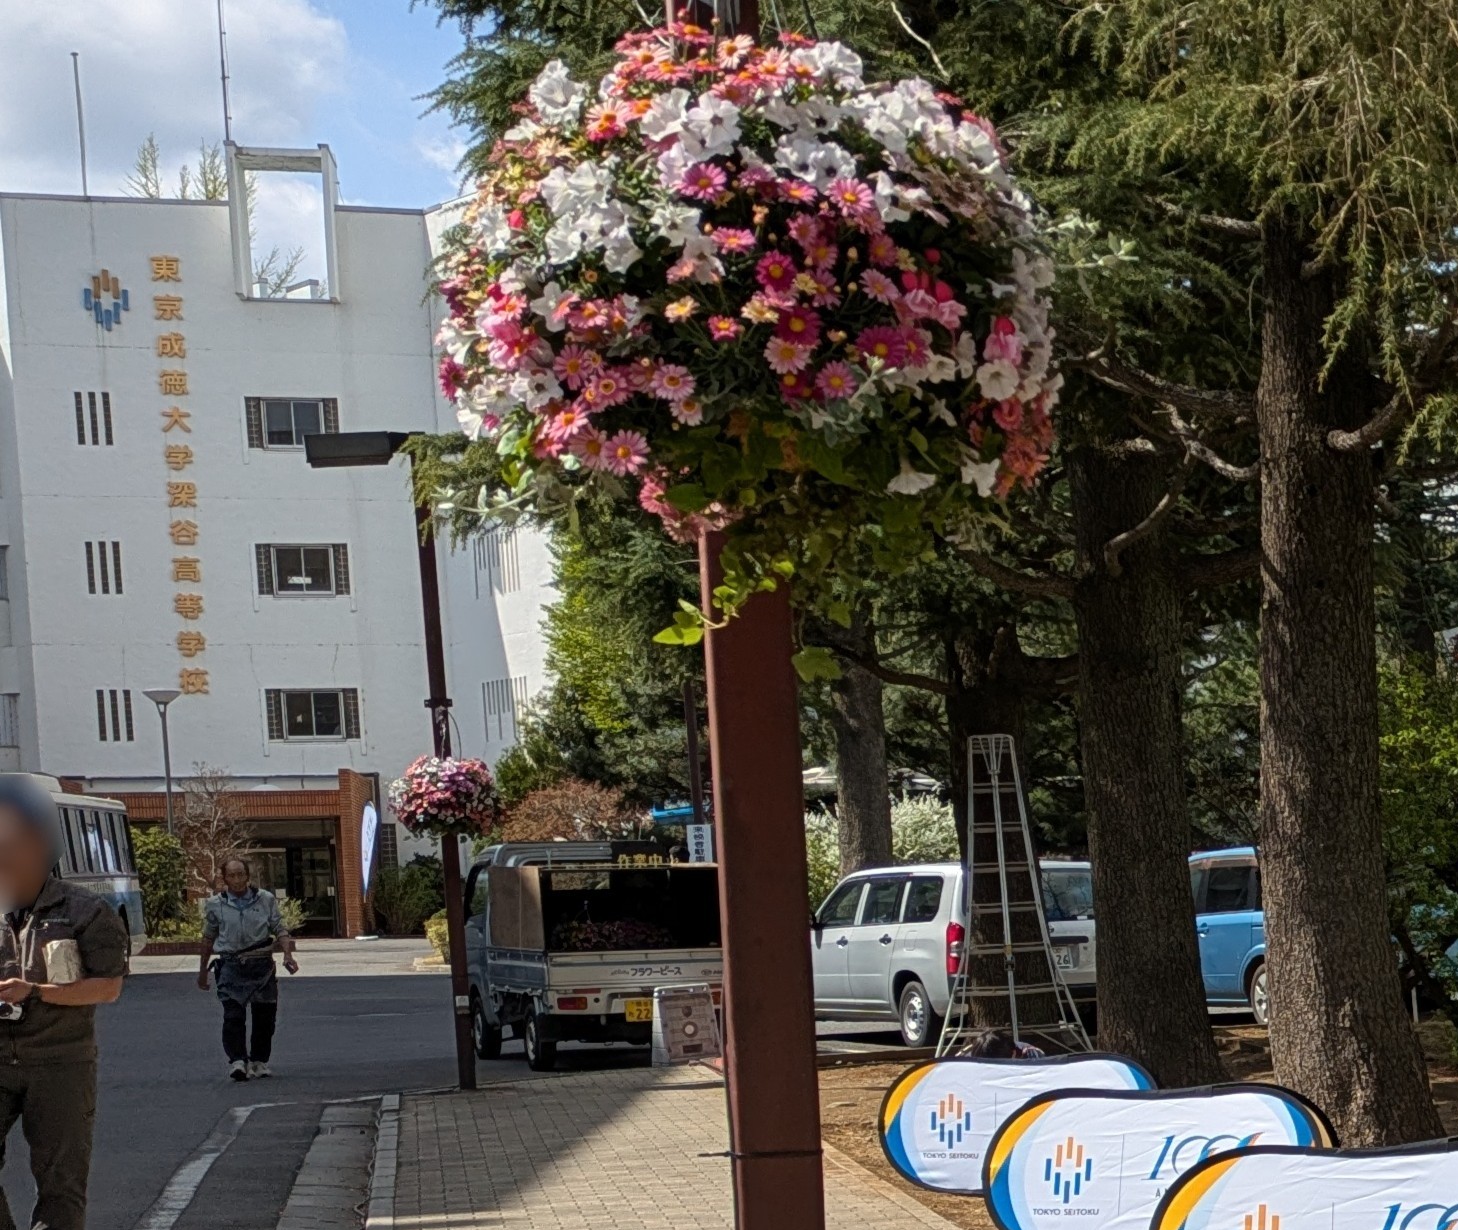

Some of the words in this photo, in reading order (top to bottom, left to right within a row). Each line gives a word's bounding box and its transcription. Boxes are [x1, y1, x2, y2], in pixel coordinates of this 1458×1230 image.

[150, 255, 208, 695] 東京成徳大学深谷高等学校
[630, 966, 682, 976] フラワーピース
[949, 1152, 979, 1160] SEITOKU
[1033, 1208, 1061, 1216] TOKYO
[1064, 1208, 1100, 1216] SEITOKU
